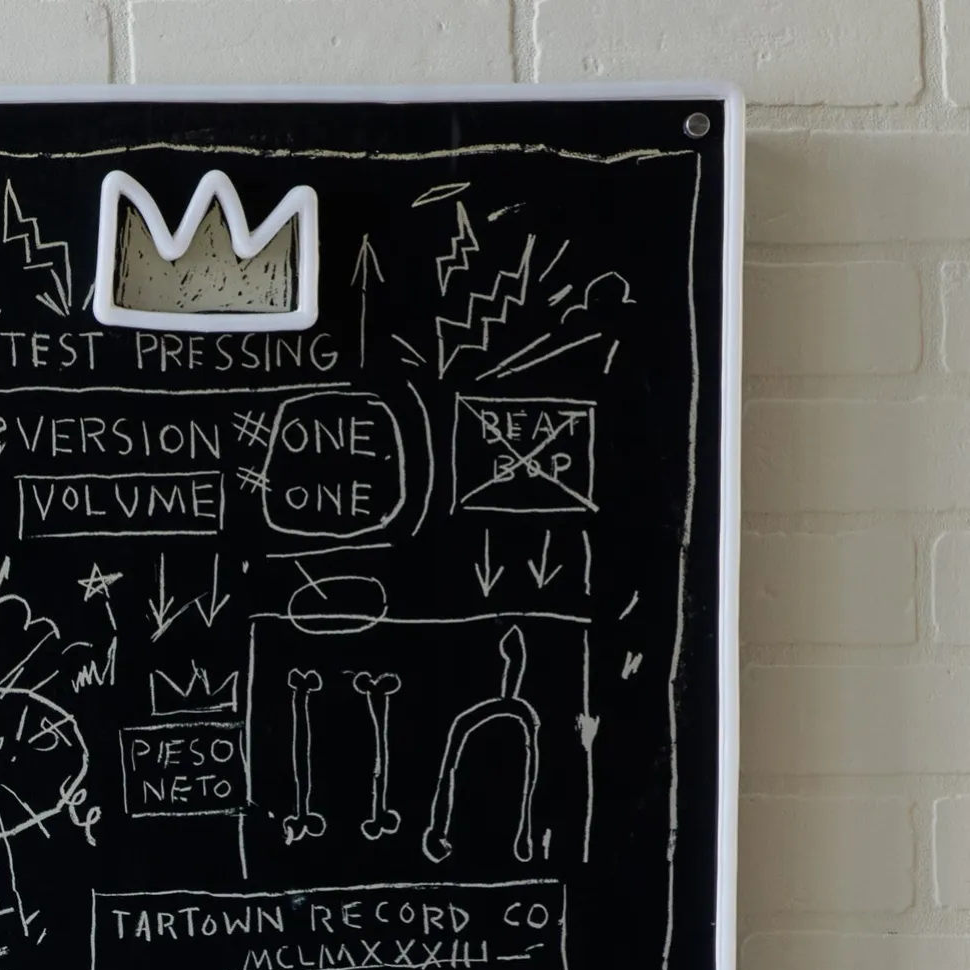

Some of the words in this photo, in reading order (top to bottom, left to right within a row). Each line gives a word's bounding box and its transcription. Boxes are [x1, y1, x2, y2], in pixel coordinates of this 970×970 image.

[135, 331, 338, 372] PRESSING
[16, 415, 220, 460] VERSION
[481, 409, 587, 444] BEAT
[493, 452, 572, 484] BOP
[33, 480, 217, 522] VOLUME
[132, 738, 234, 770] PIESO
[143, 776, 231, 803] NETO
[112, 906, 283, 942] TARTOWN
[310, 901, 470, 935] RECORD
